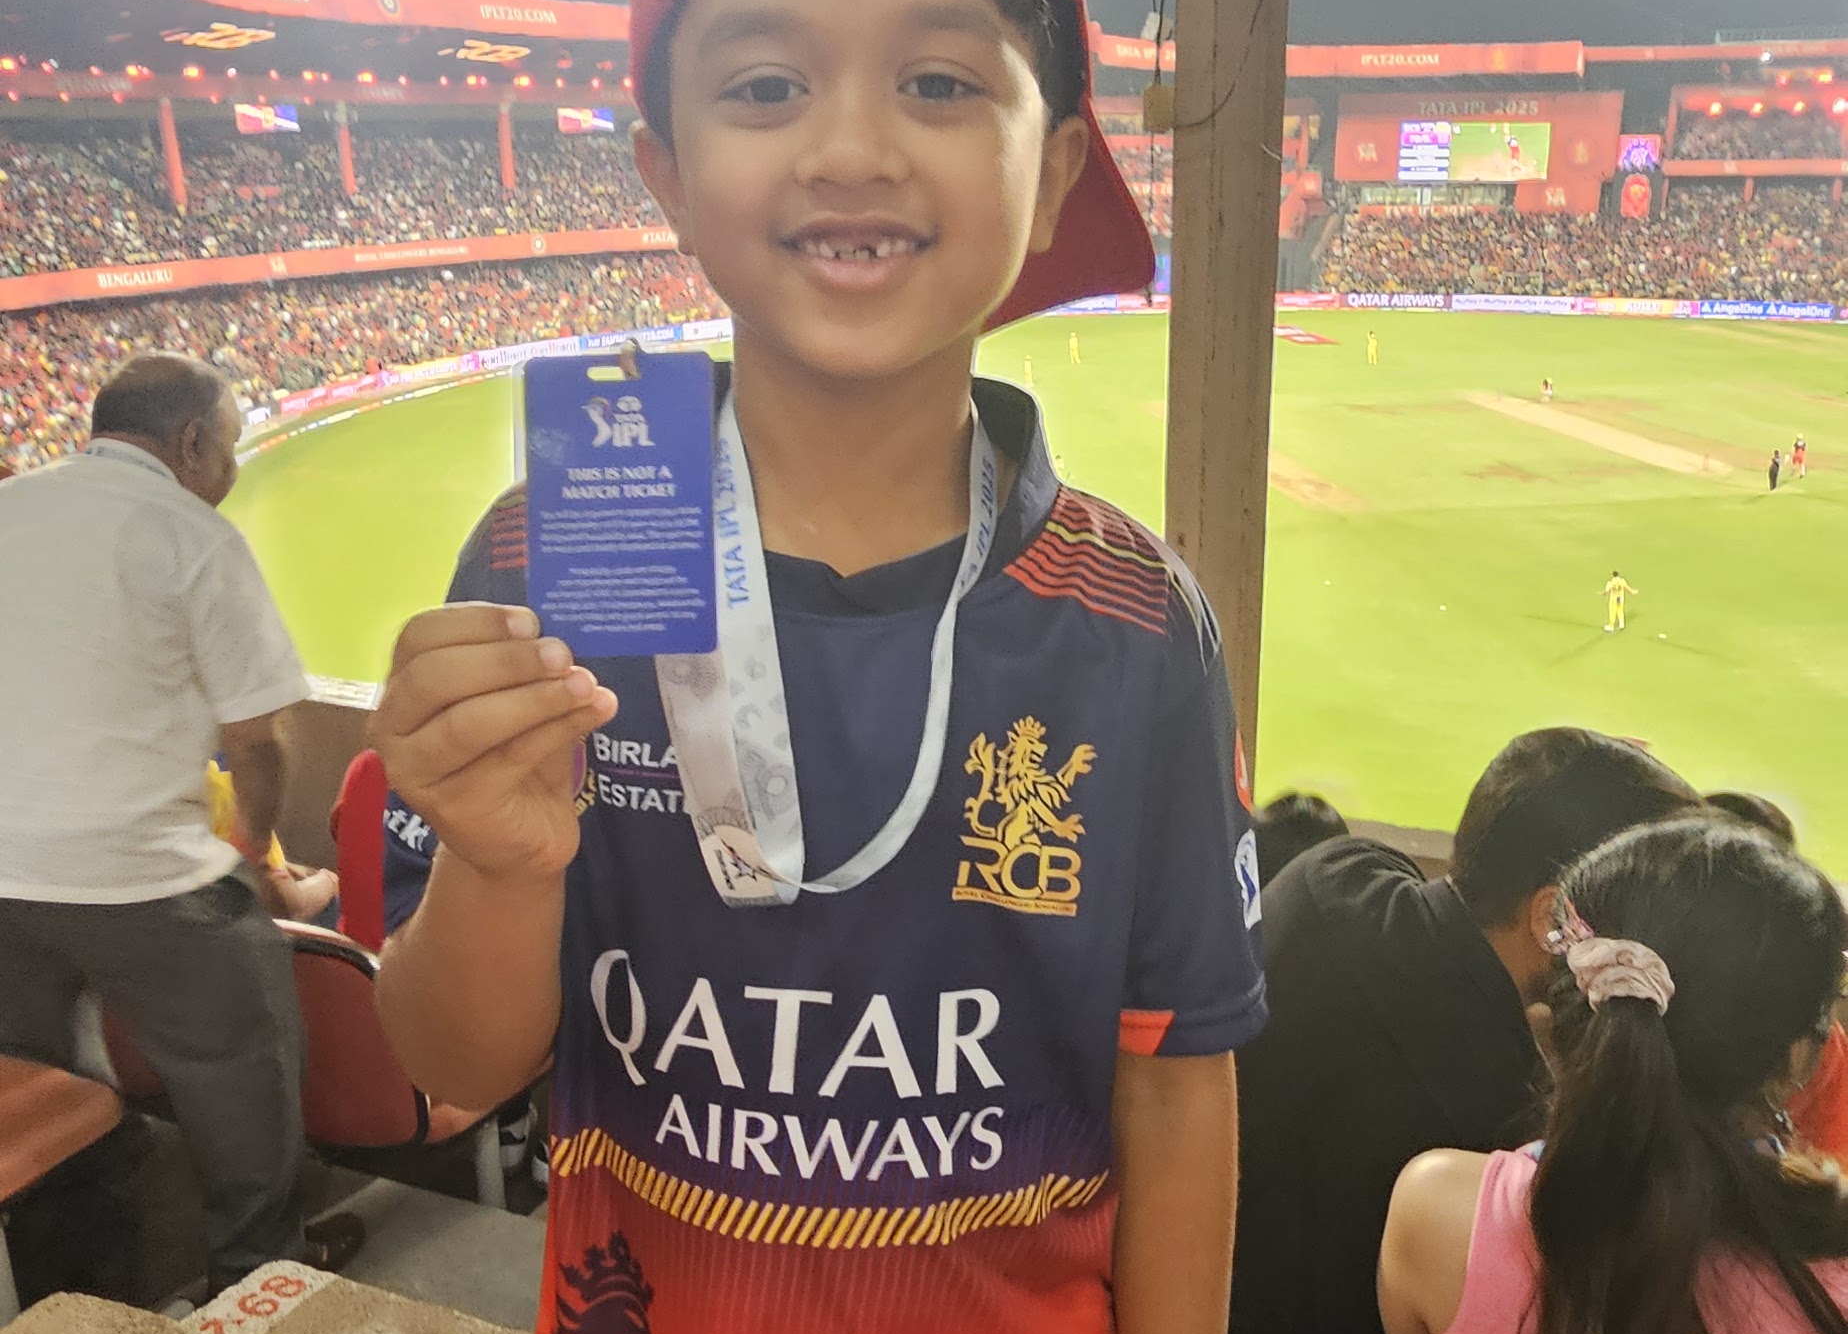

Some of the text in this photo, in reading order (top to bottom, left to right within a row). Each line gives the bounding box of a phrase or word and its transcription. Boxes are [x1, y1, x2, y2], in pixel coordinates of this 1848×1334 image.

[480, 3, 557, 25] IPLT20.COM
[1419, 100, 1540, 116] TATA IPL 2025
[97, 268, 173, 289] BENGALURU
[1347, 293, 1444, 308] QATAR AIRWAYS
[612, 422, 656, 448] IPL
[567, 464, 673, 482] THIS IS NOT A
[562, 482, 676, 499] MATCH TICKET
[714, 501, 742, 539] IPL
[721, 543, 750, 610] TATA
[597, 773, 684, 814] ESTAT
[959, 835, 1082, 902] RCB
[590, 948, 1005, 1099] QATAR
[655, 1094, 1005, 1182] AIRWAYS
